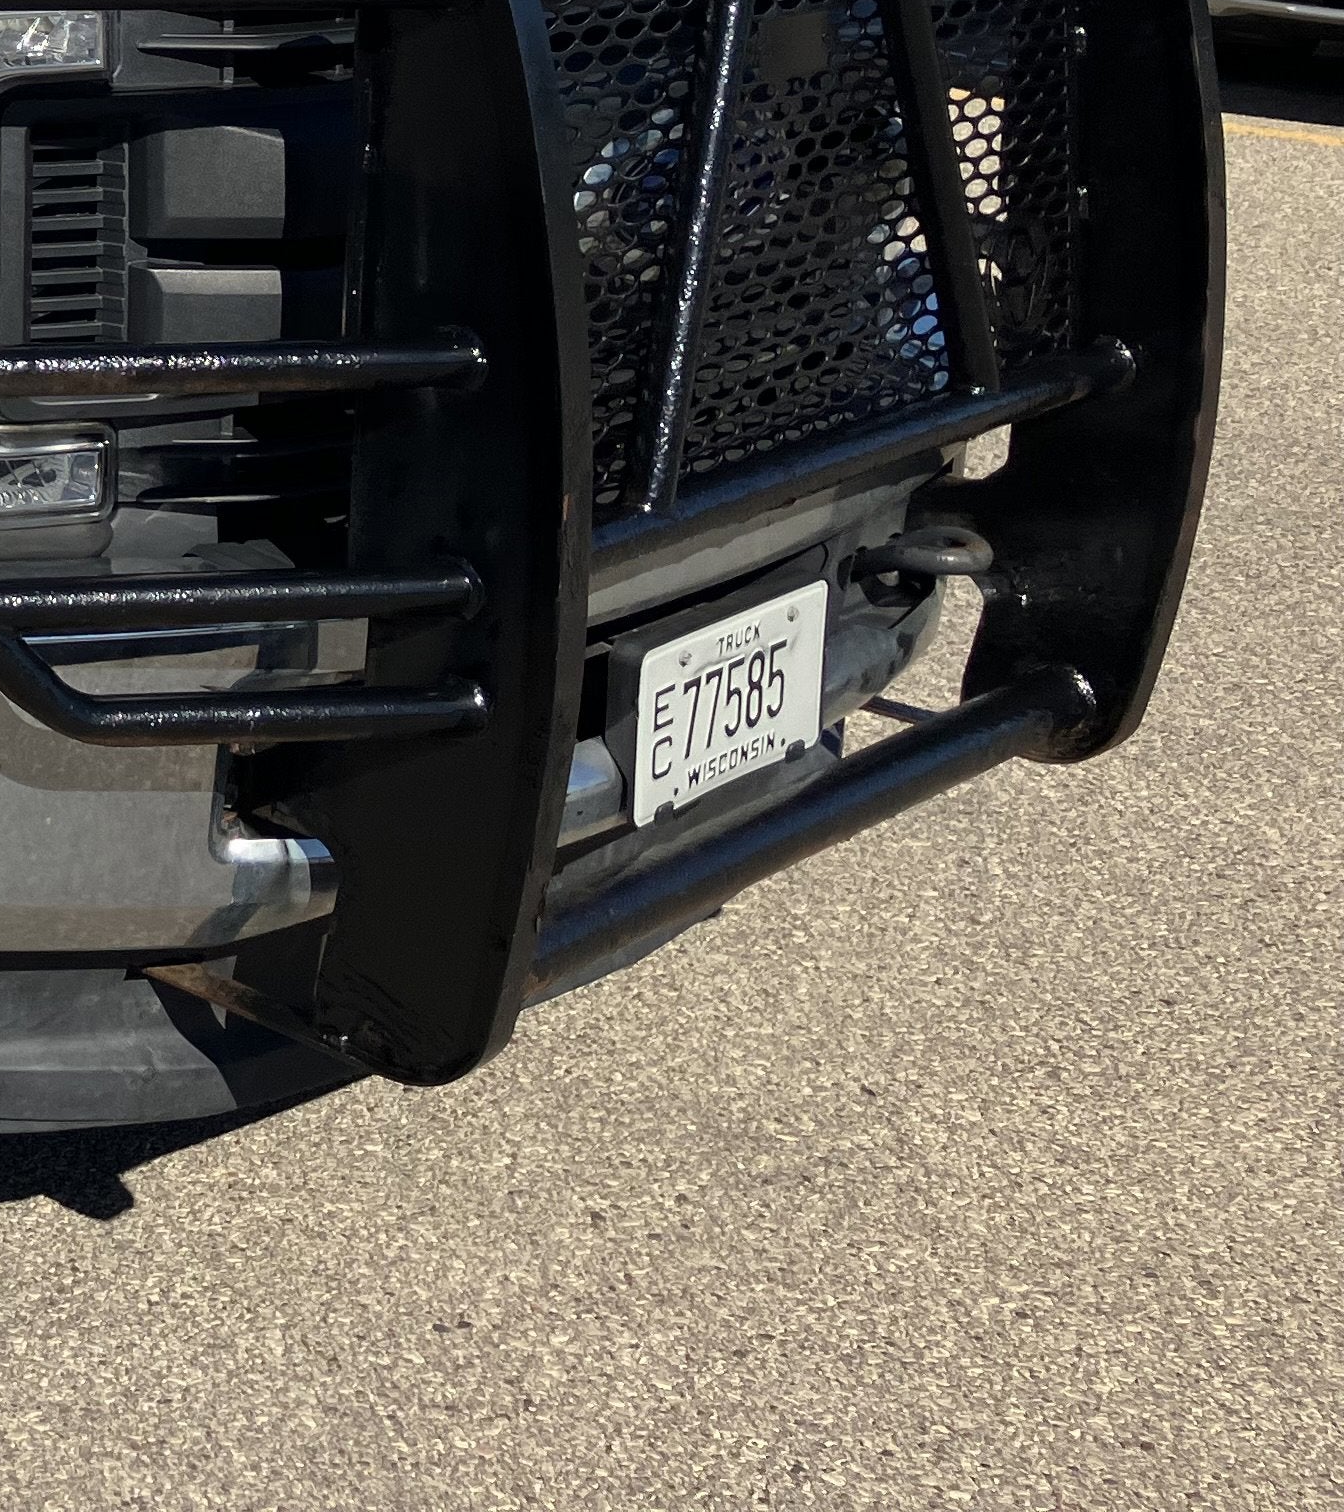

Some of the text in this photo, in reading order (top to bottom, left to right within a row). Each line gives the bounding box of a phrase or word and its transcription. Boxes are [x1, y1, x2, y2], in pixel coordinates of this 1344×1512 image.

[716, 623, 761, 656] TRUCK
[682, 638, 788, 760] 77585
[687, 735, 775, 789] WISCONSIN
